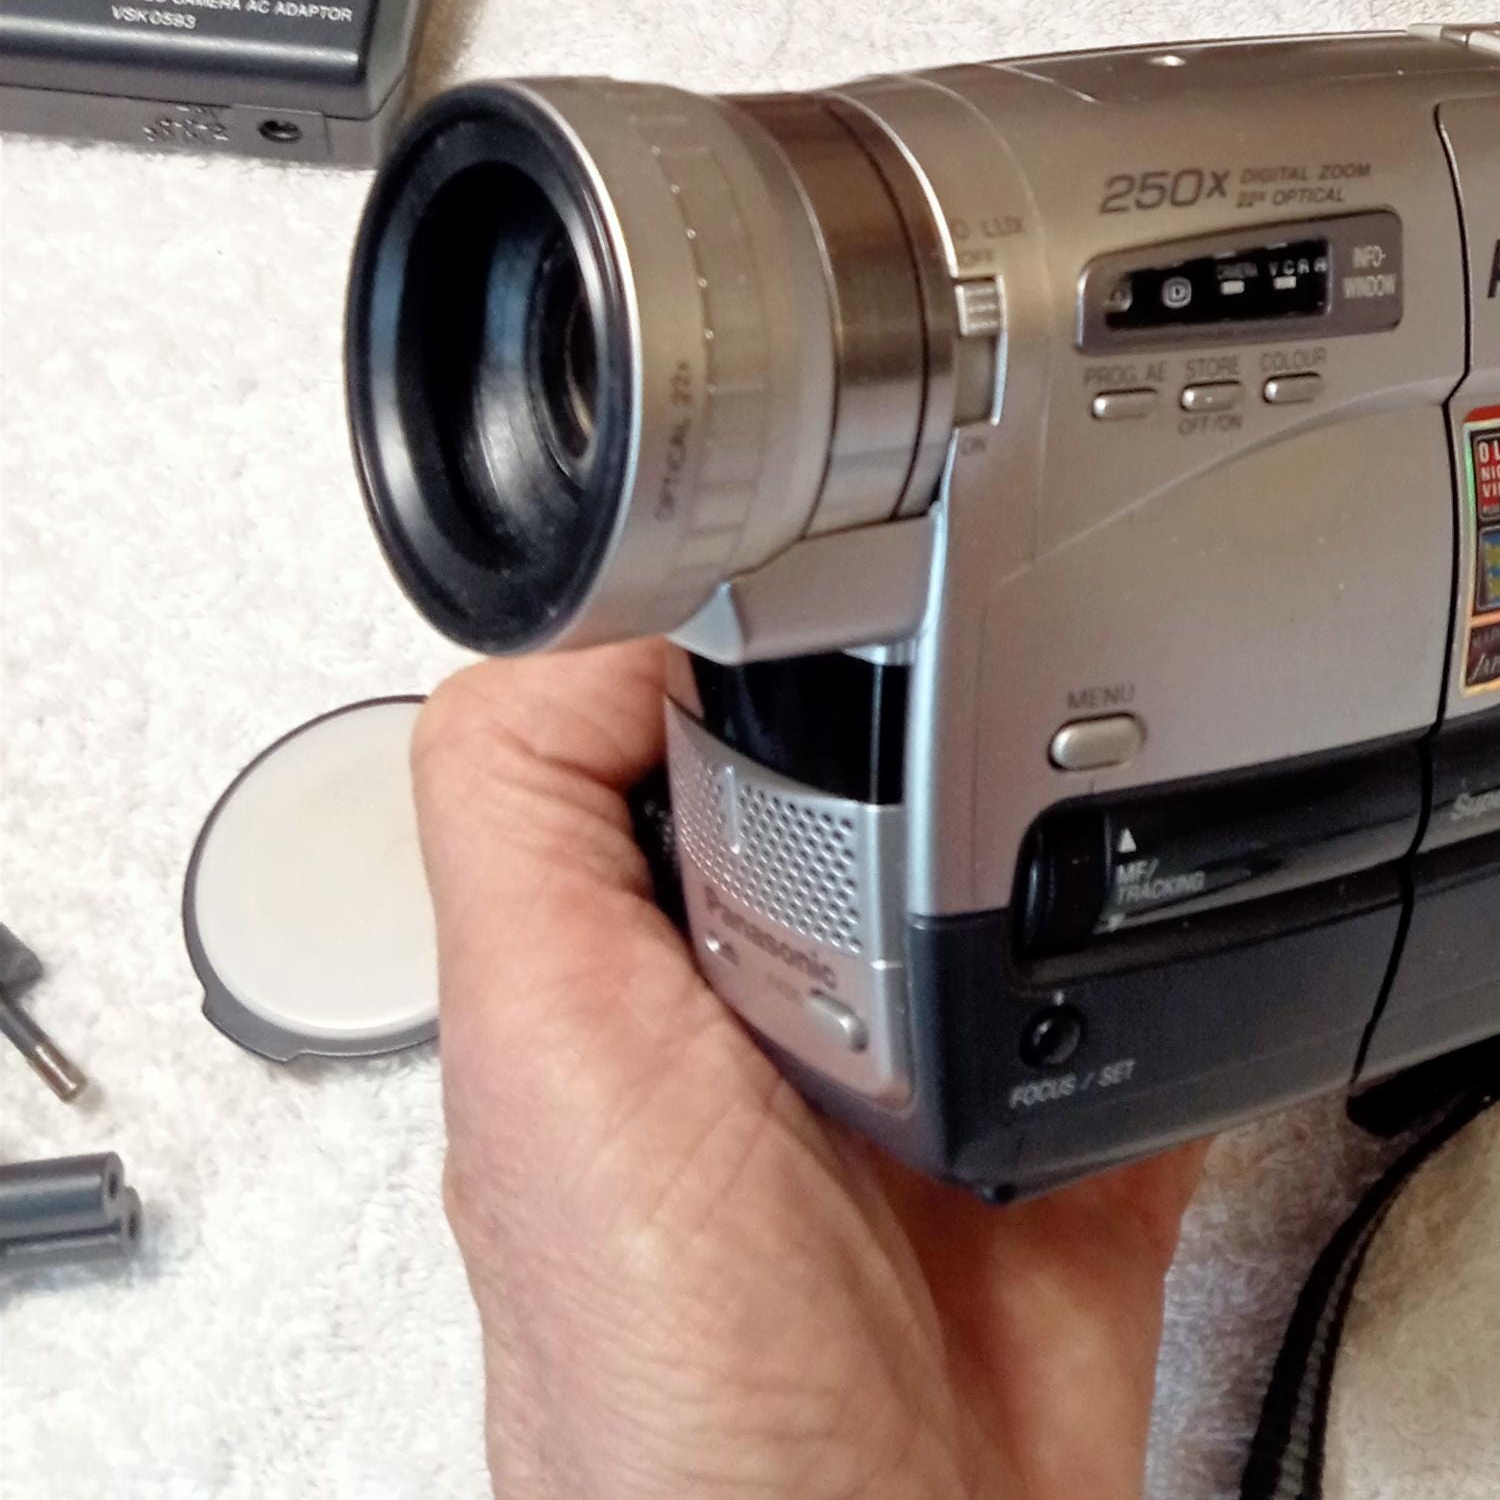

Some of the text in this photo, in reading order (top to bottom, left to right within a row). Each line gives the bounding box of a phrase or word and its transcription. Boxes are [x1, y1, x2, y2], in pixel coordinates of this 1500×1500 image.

[245, 0, 271, 14] AC
[274, 2, 354, 22] ADAPTOR
[1240, 164, 1371, 184] DIGITAL ZOOM
[1272, 187, 1343, 206] OPTICAL
[1343, 274, 1397, 298] WINDOW
[1184, 356, 1240, 379] STORE
[1260, 348, 1327, 372] COLOUR
[1066, 685, 1136, 708] MENU
